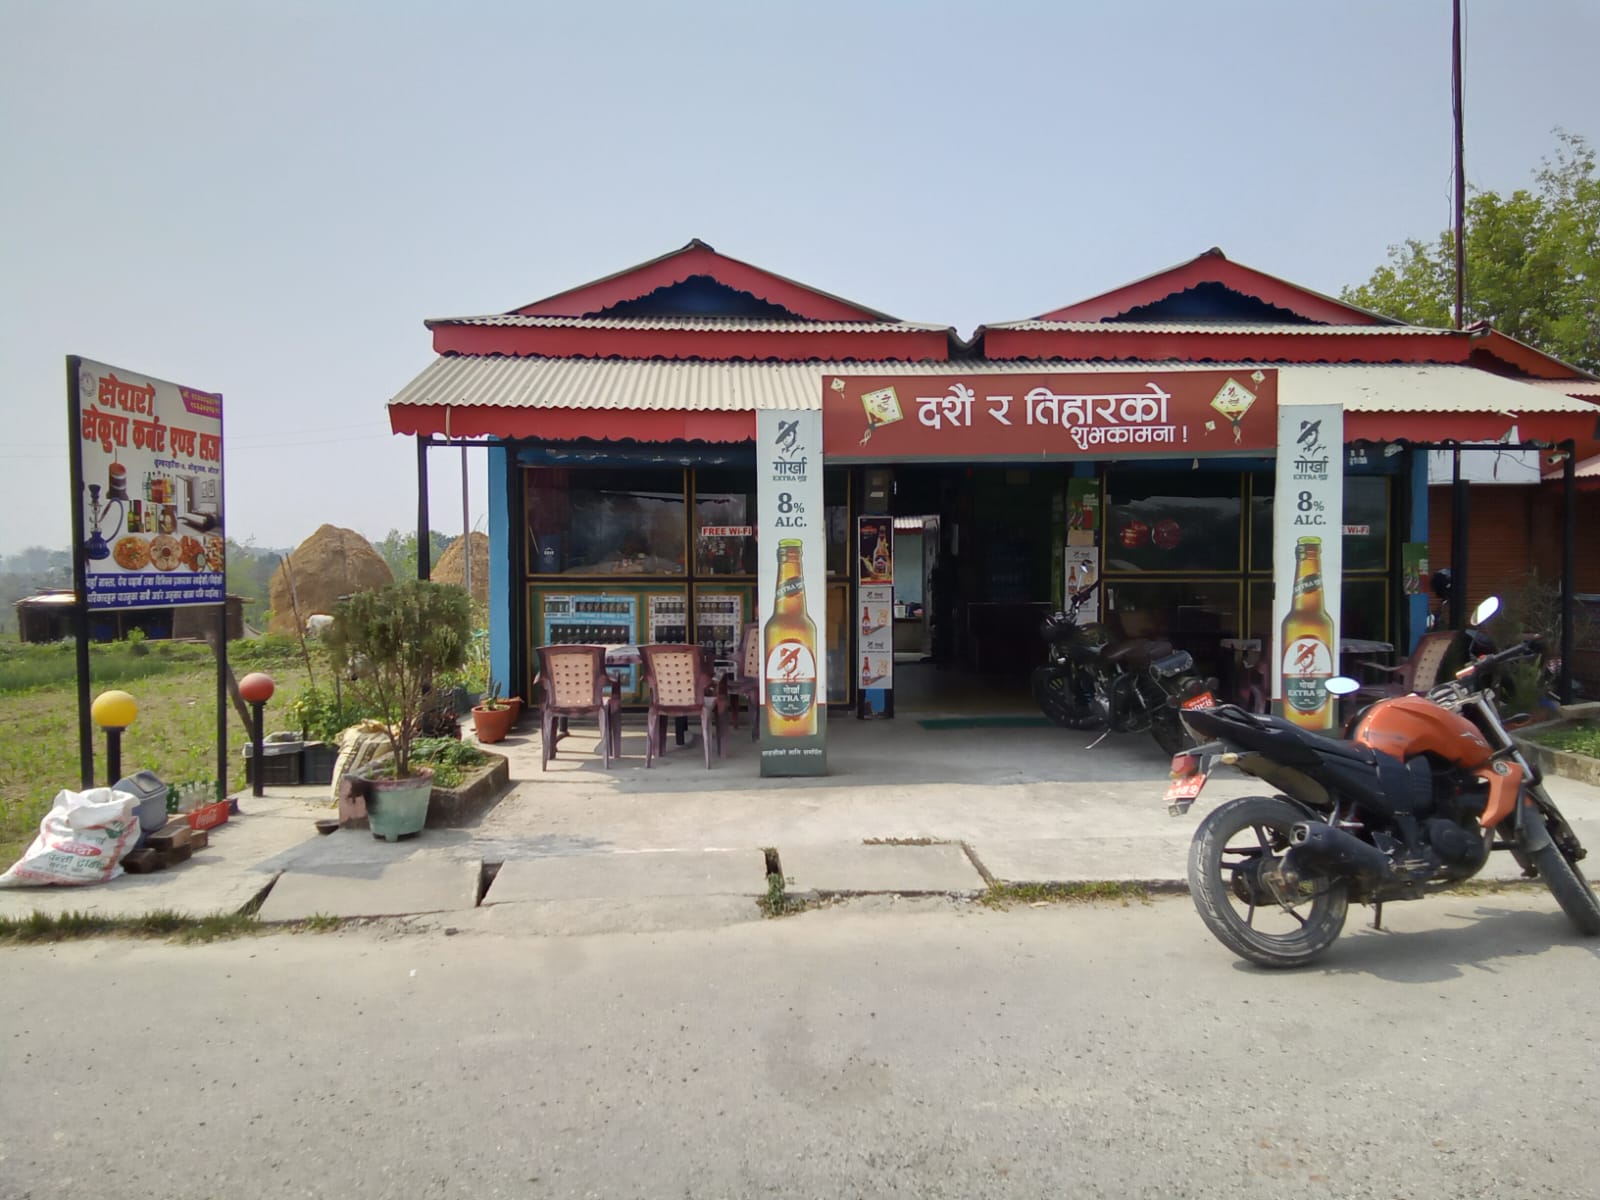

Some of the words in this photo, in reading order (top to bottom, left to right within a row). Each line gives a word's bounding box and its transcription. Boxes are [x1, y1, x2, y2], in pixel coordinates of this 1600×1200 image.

[916, 383, 975, 429] दशैं
[986, 396, 1013, 426] र
[1024, 382, 1171, 429] तिहारको
[82, 403, 129, 453] सेकुवा
[1070, 425, 1176, 450] शुभकामना
[772, 456, 808, 474] गोर्खा
[1293, 455, 1329, 473] गोर्खा
[778, 492, 805, 514] 8%
[1297, 491, 1325, 512] 8%
[775, 516, 808, 527] ALC.
[1294, 514, 1327, 525] ALC.
[703, 527, 727, 536] FREE
[729, 527, 752, 536] Wi-Fi
